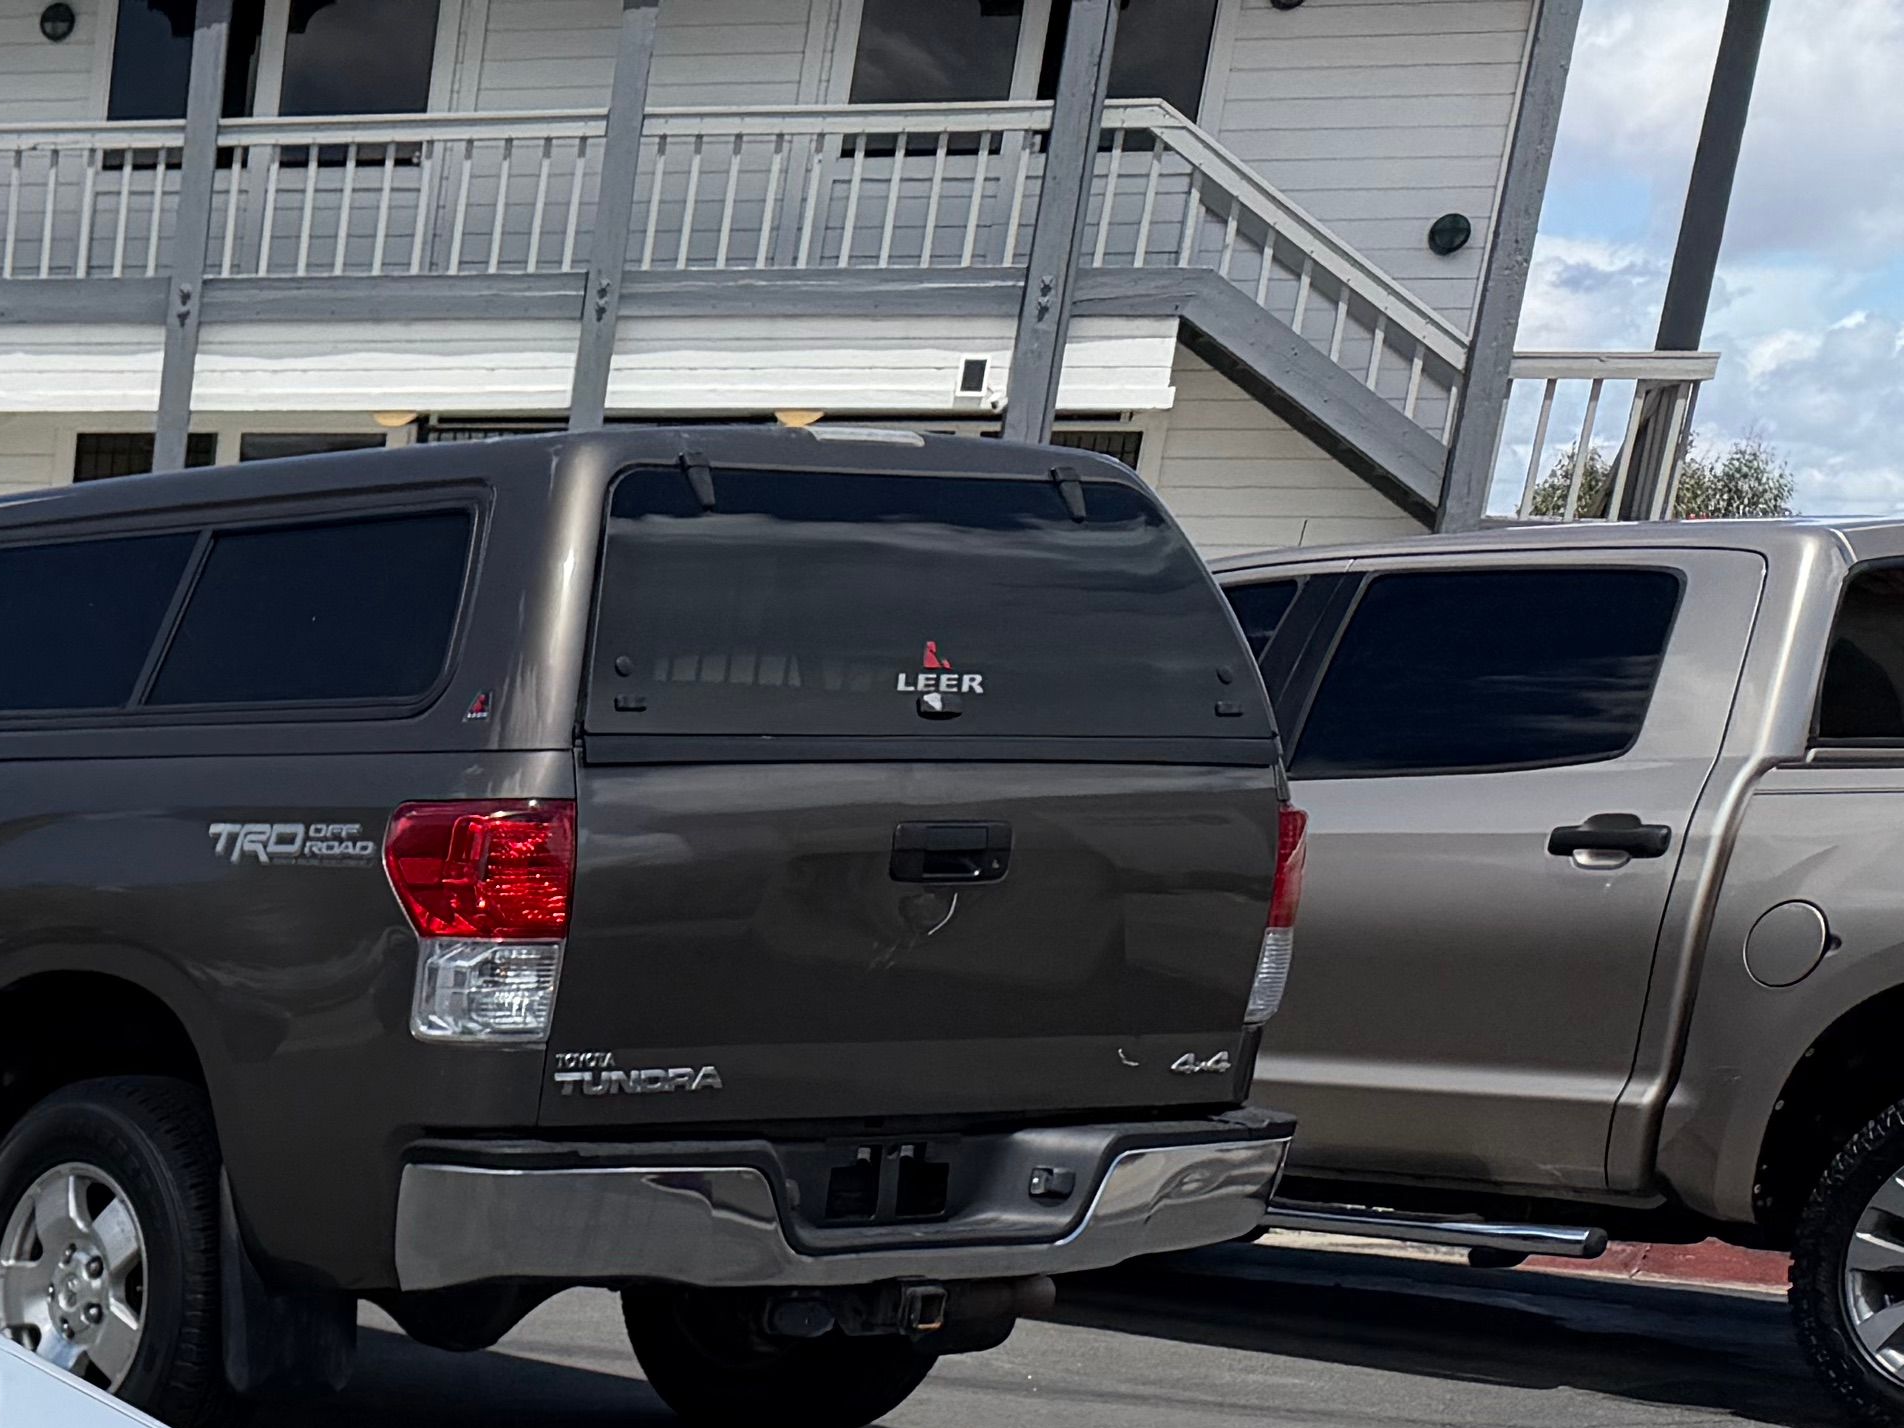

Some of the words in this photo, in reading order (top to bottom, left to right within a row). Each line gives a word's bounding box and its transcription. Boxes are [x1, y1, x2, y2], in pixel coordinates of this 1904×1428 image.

[897, 673, 984, 693] LEER
[309, 823, 362, 837] OFF
[208, 823, 305, 864] TRD
[304, 841, 375, 856] ROAD
[555, 1052, 616, 1068] TOYOTA
[554, 1065, 724, 1096] TUNDRA
